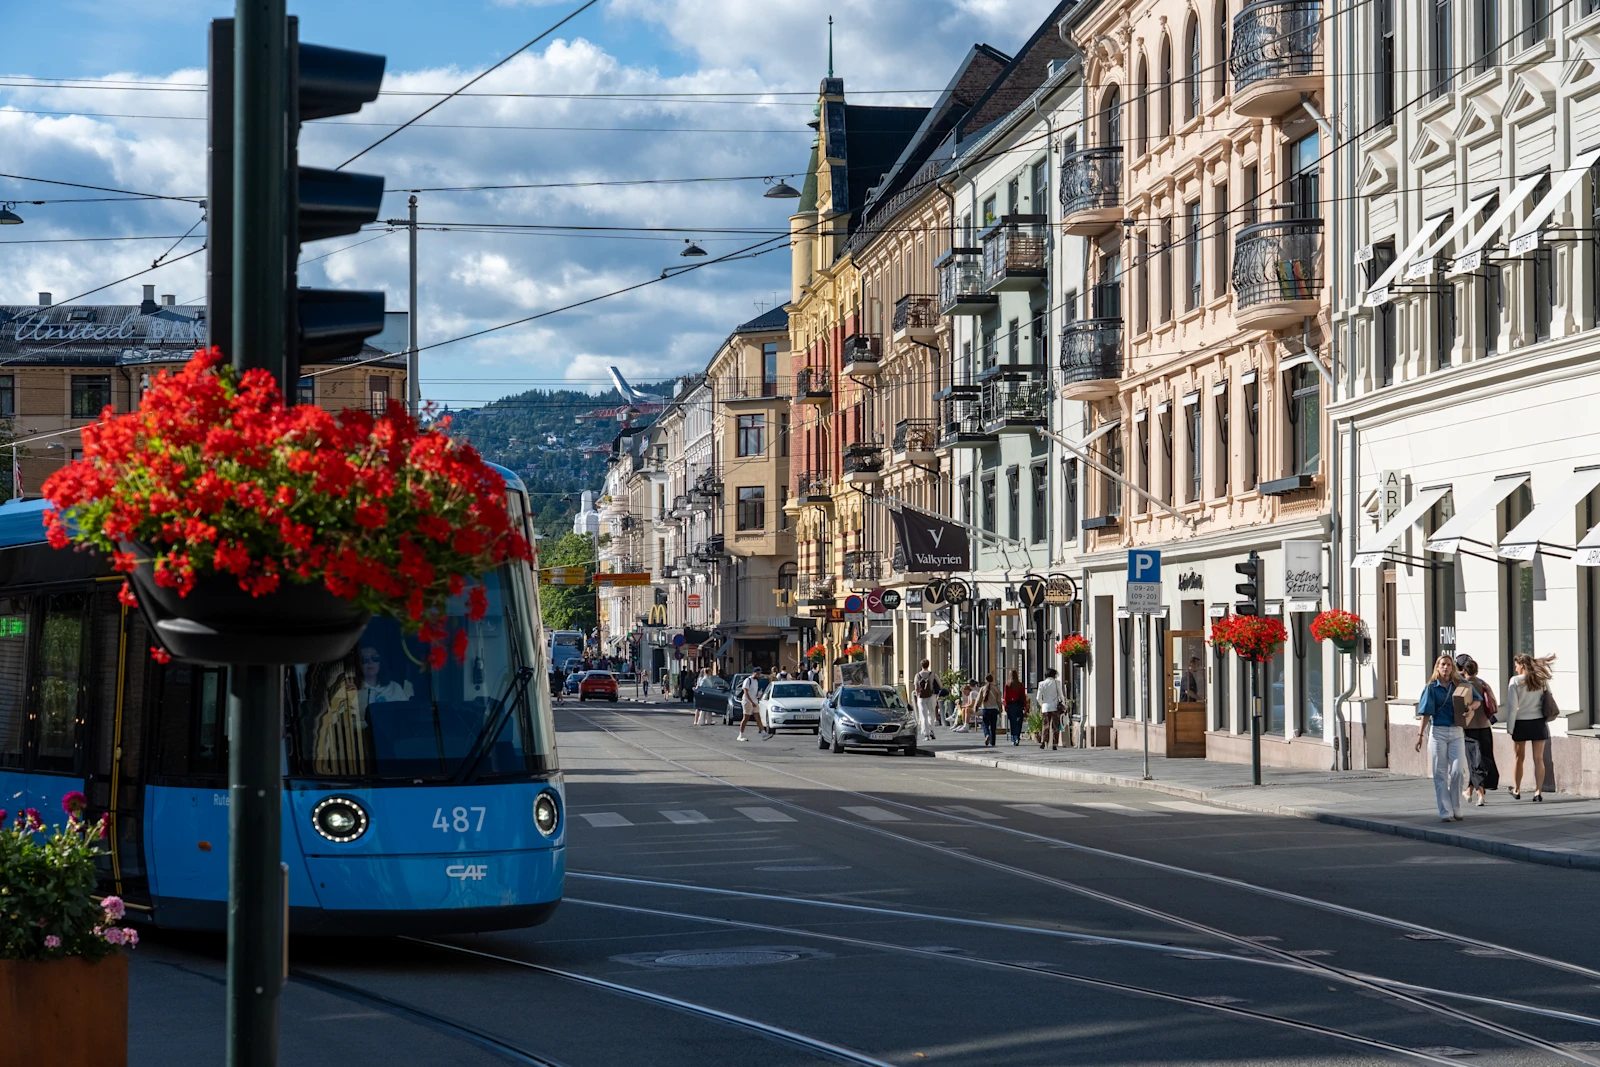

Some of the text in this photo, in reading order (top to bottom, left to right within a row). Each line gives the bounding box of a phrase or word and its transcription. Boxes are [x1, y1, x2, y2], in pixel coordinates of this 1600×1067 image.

[1515, 235, 1533, 253] ARKET
[12, 308, 135, 341] United
[1386, 472, 1398, 559] ARKT
[915, 553, 962, 567] Valkyrien
[1135, 554, 1153, 579] P
[1286, 581, 1320, 593] Stories
[432, 806, 487, 833] 487
[445, 864, 488, 881] CAF
